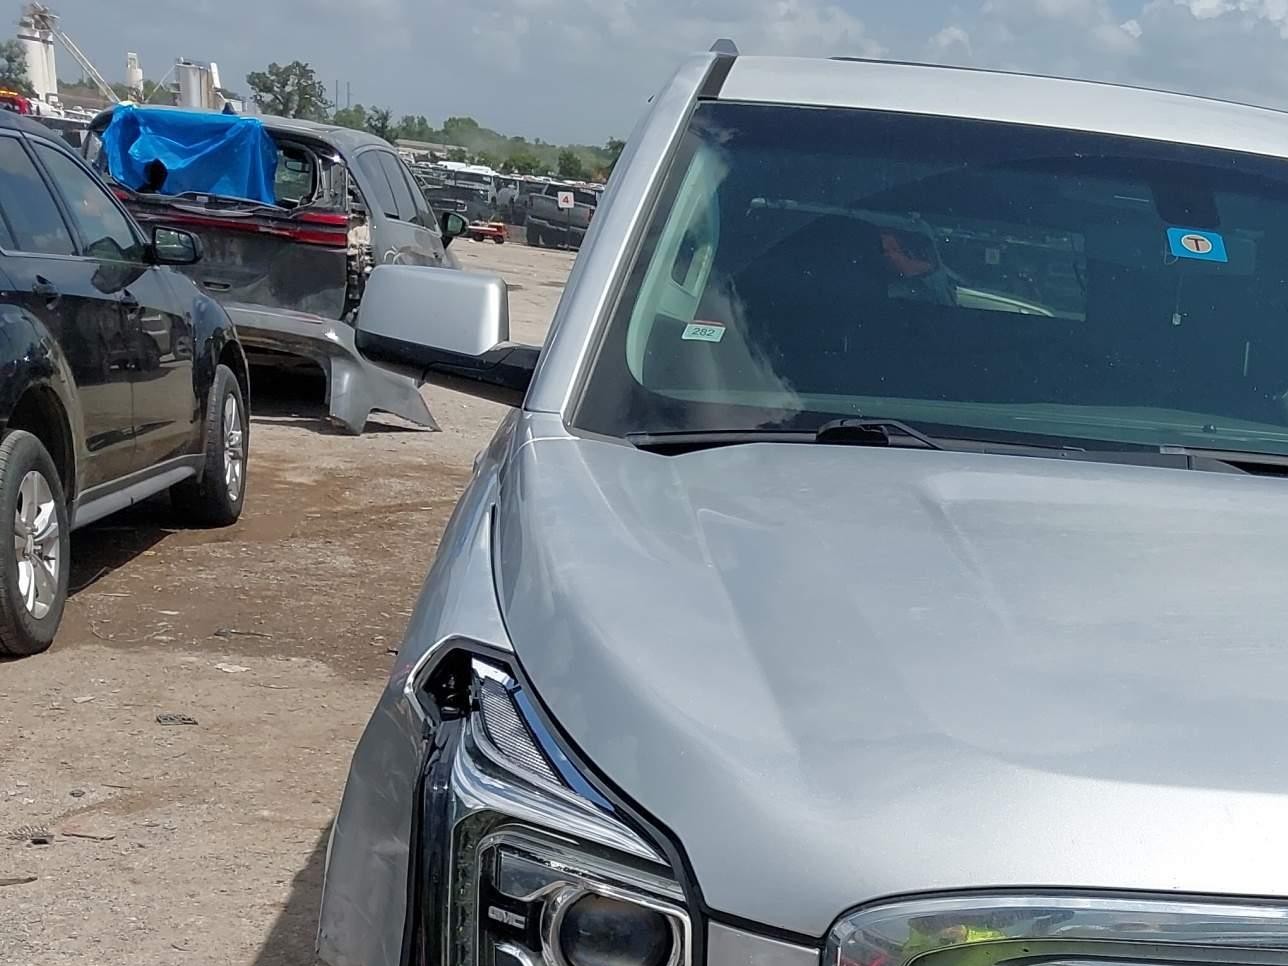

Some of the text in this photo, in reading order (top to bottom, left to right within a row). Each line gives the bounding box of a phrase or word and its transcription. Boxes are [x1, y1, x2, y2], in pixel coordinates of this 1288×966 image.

[562, 195, 570, 204] 4
[1186, 236, 1206, 252] T
[691, 327, 716, 337] 282
[488, 905, 526, 929] GMC
